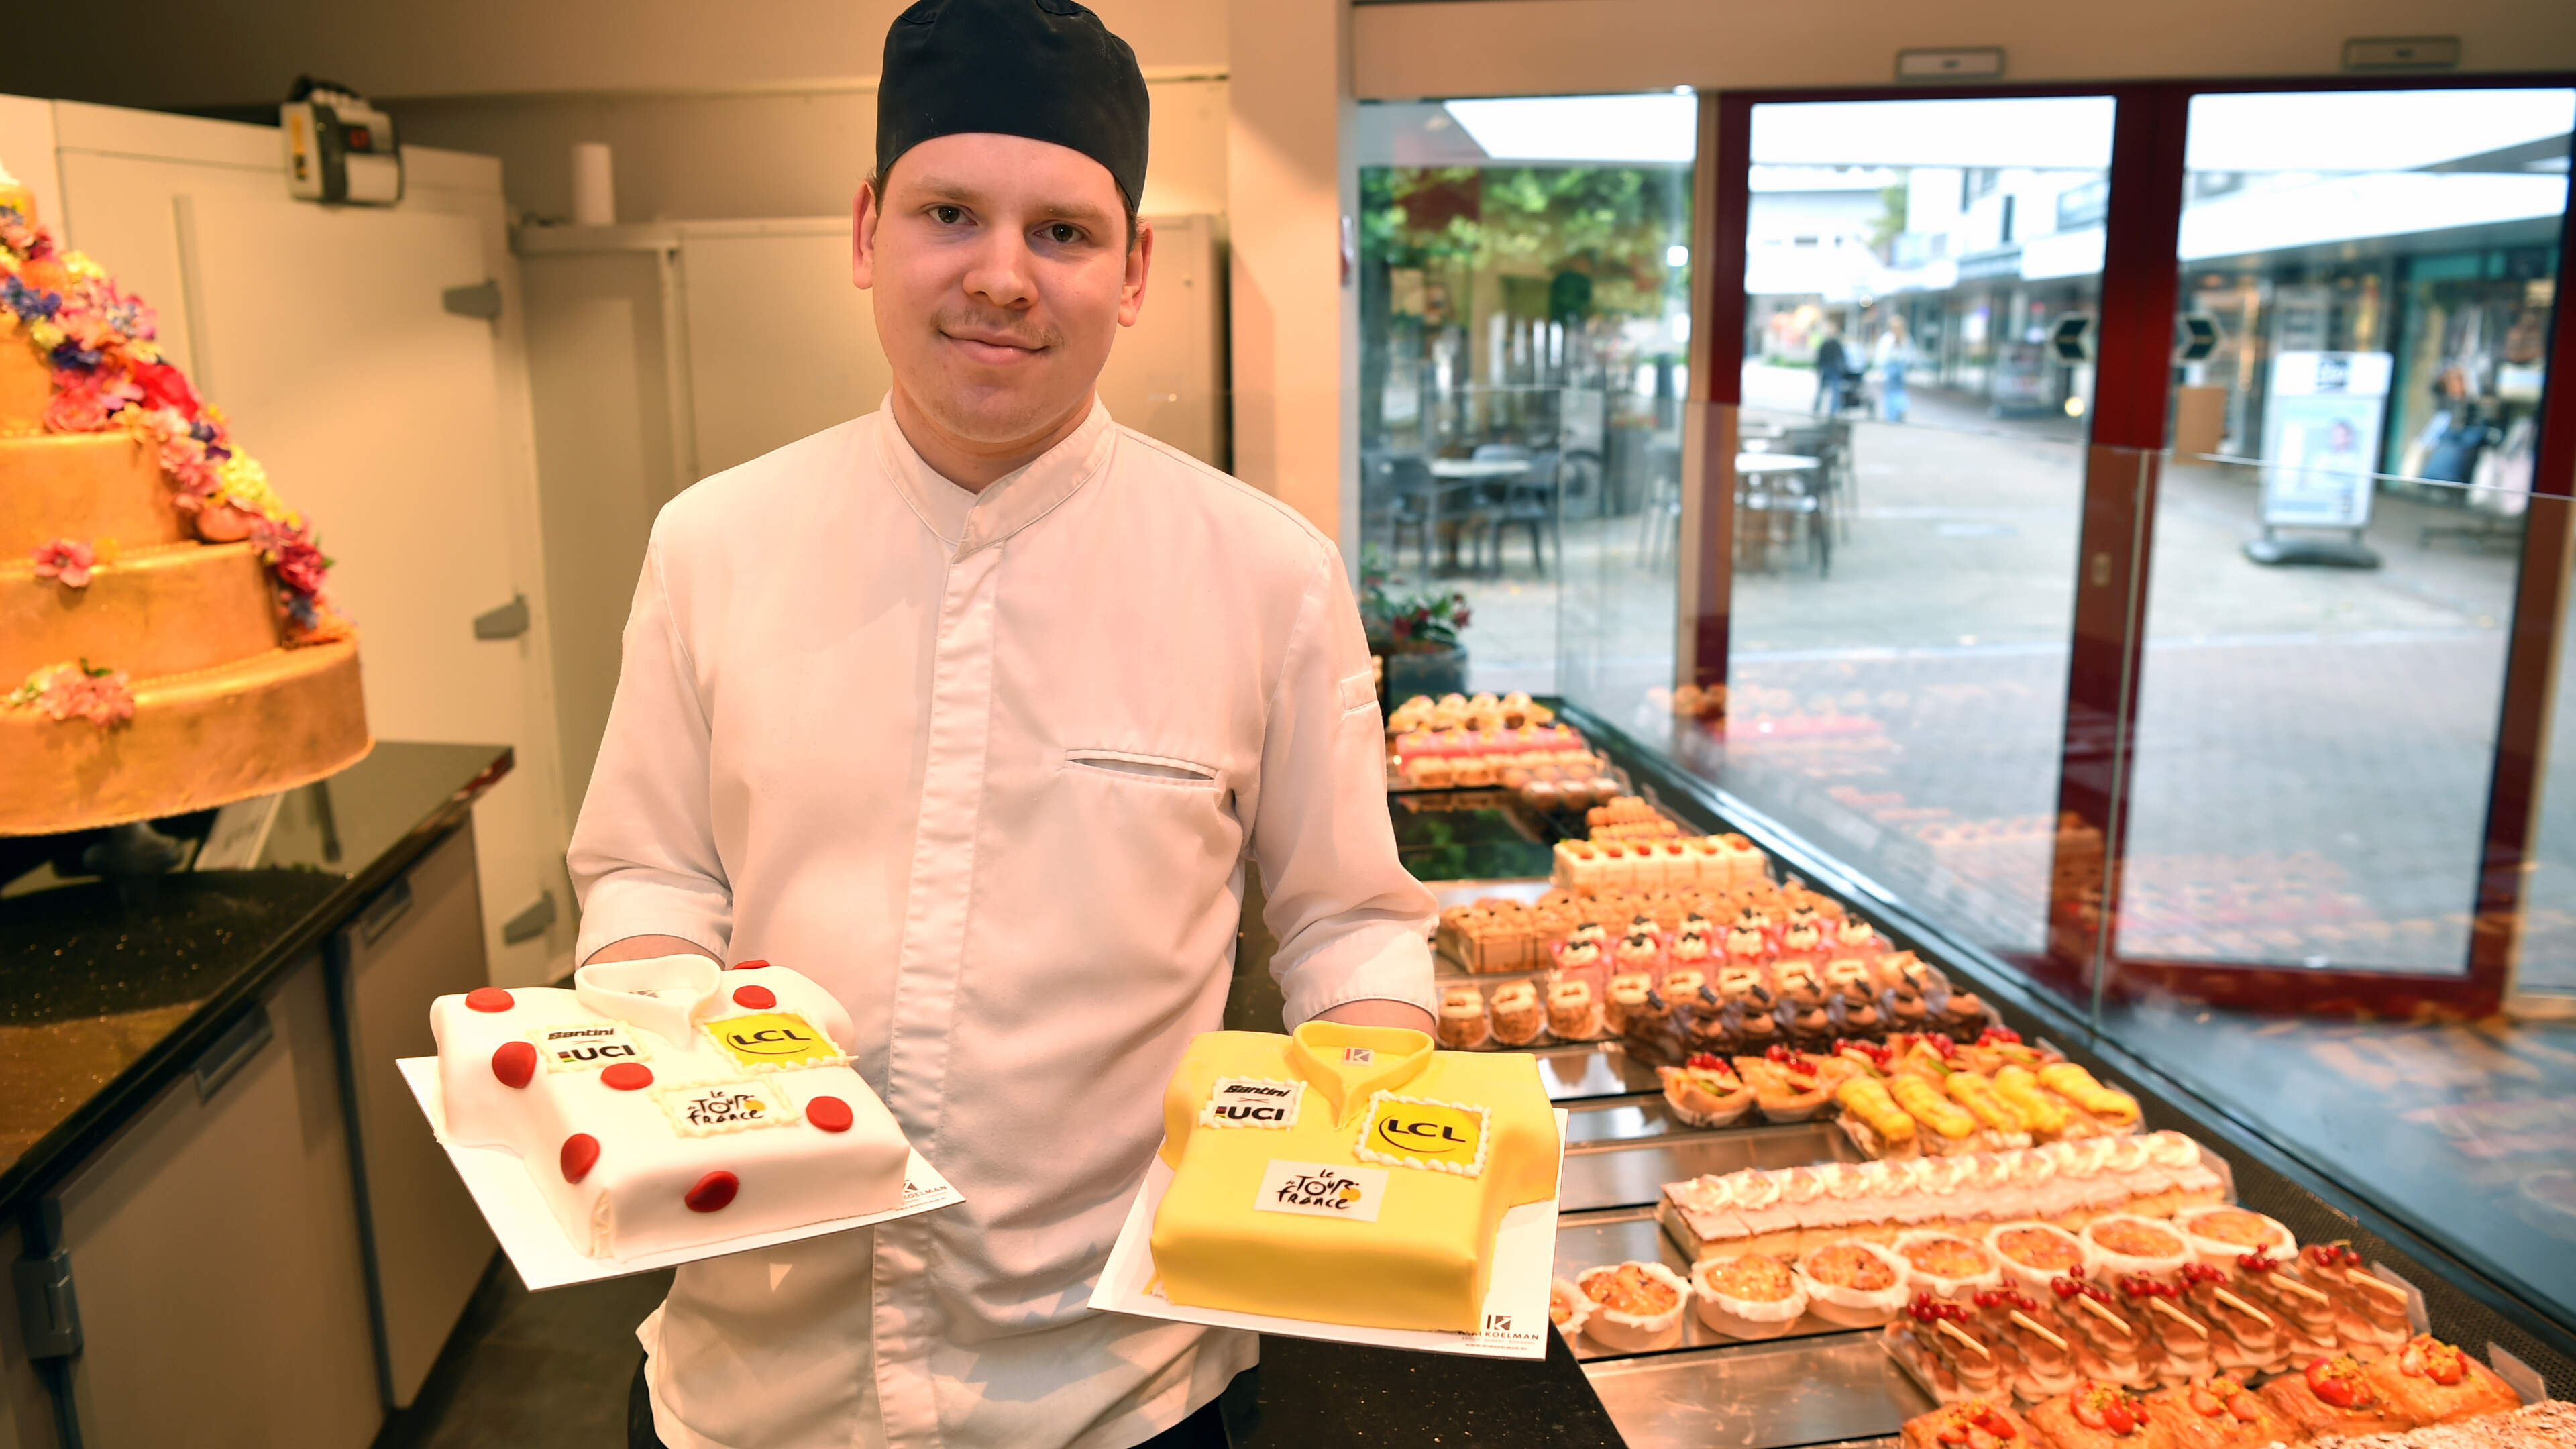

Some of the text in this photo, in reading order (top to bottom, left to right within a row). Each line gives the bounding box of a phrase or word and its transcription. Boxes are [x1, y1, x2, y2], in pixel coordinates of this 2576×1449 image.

[547, 1028, 614, 1040] Santini
[731, 1030, 812, 1045] LCL
[571, 1044, 635, 1061] UCI
[1223, 1085, 1291, 1097] Santini
[1227, 1106, 1285, 1121] UCI
[1387, 1119, 1466, 1142] LCL
[1485, 1331, 1539, 1340] KOELMAN
